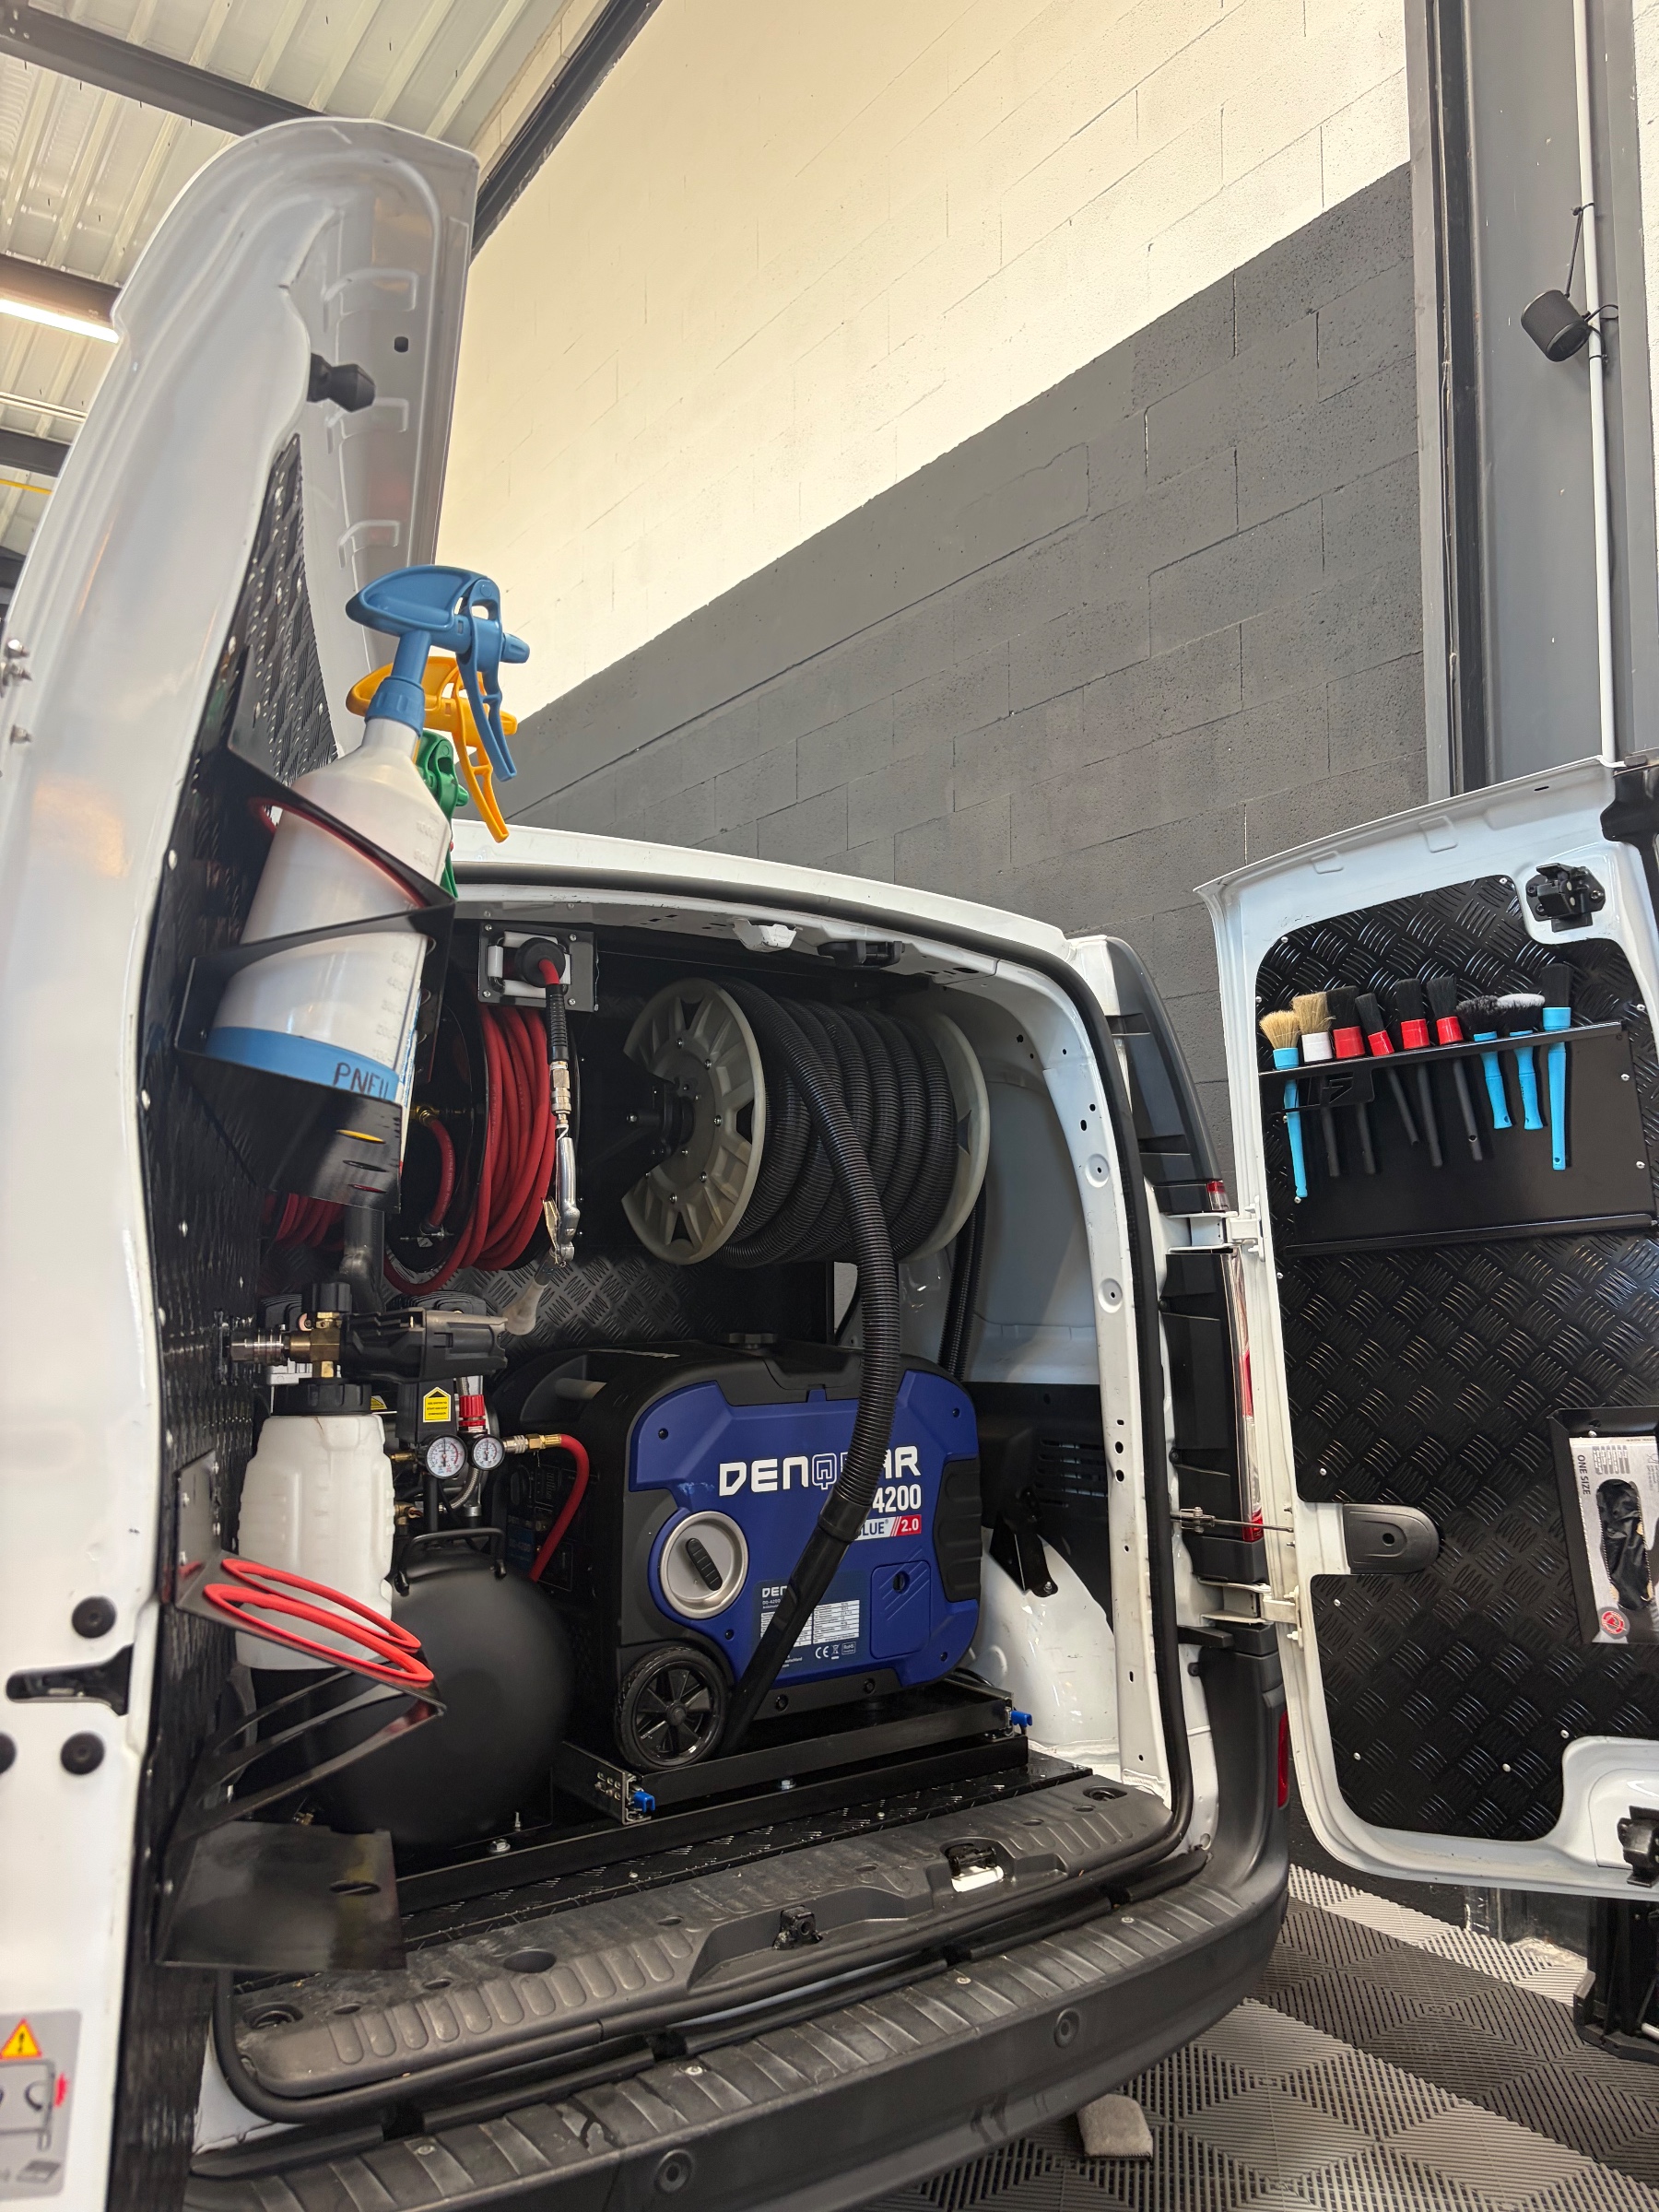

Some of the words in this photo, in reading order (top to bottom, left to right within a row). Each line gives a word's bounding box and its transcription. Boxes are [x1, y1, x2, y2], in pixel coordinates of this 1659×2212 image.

[333, 1062, 389, 1100] PNEU
[1577, 1454, 1588, 1475] ONE
[1580, 1476, 1591, 1495] SIZE
[872, 1484, 922, 1513] 4200
[900, 1517, 920, 1533] 2.0
